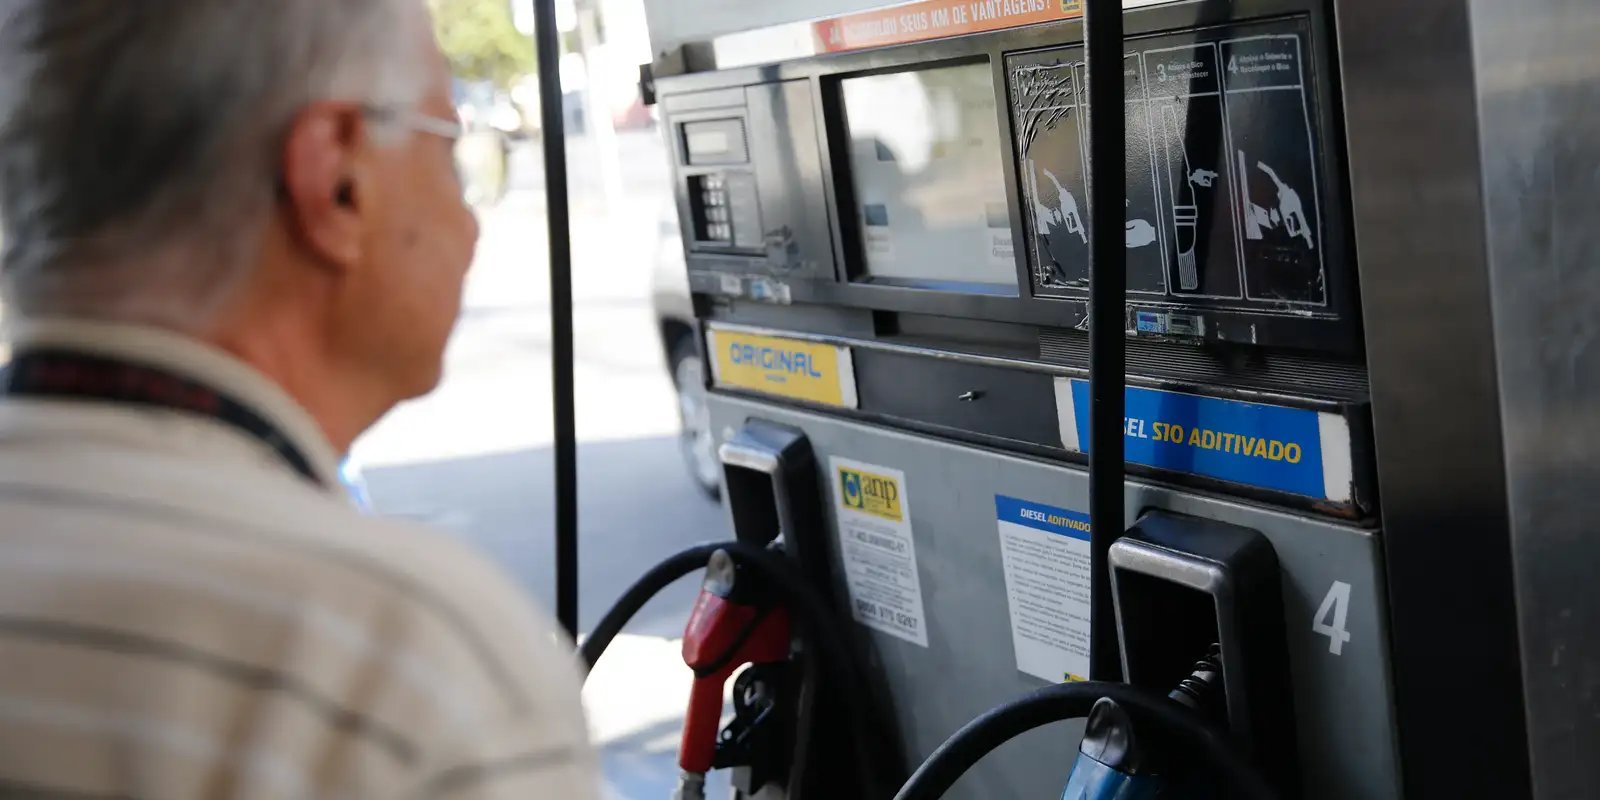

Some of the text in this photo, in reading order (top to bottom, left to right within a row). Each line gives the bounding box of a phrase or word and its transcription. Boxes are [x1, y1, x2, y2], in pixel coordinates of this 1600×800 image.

[900, 13, 928, 33] SEUS
[930, 8, 950, 28] KM
[953, 4, 968, 25] DE
[1228, 55, 1238, 73] 4
[730, 343, 822, 378] ORIGINAL
[1124, 416, 1301, 464] EL S10 ADITIVADO
[863, 476, 897, 508] anp
[1020, 508, 1091, 532] DIESEL ADITIVADO
[1312, 580, 1351, 656] 4
